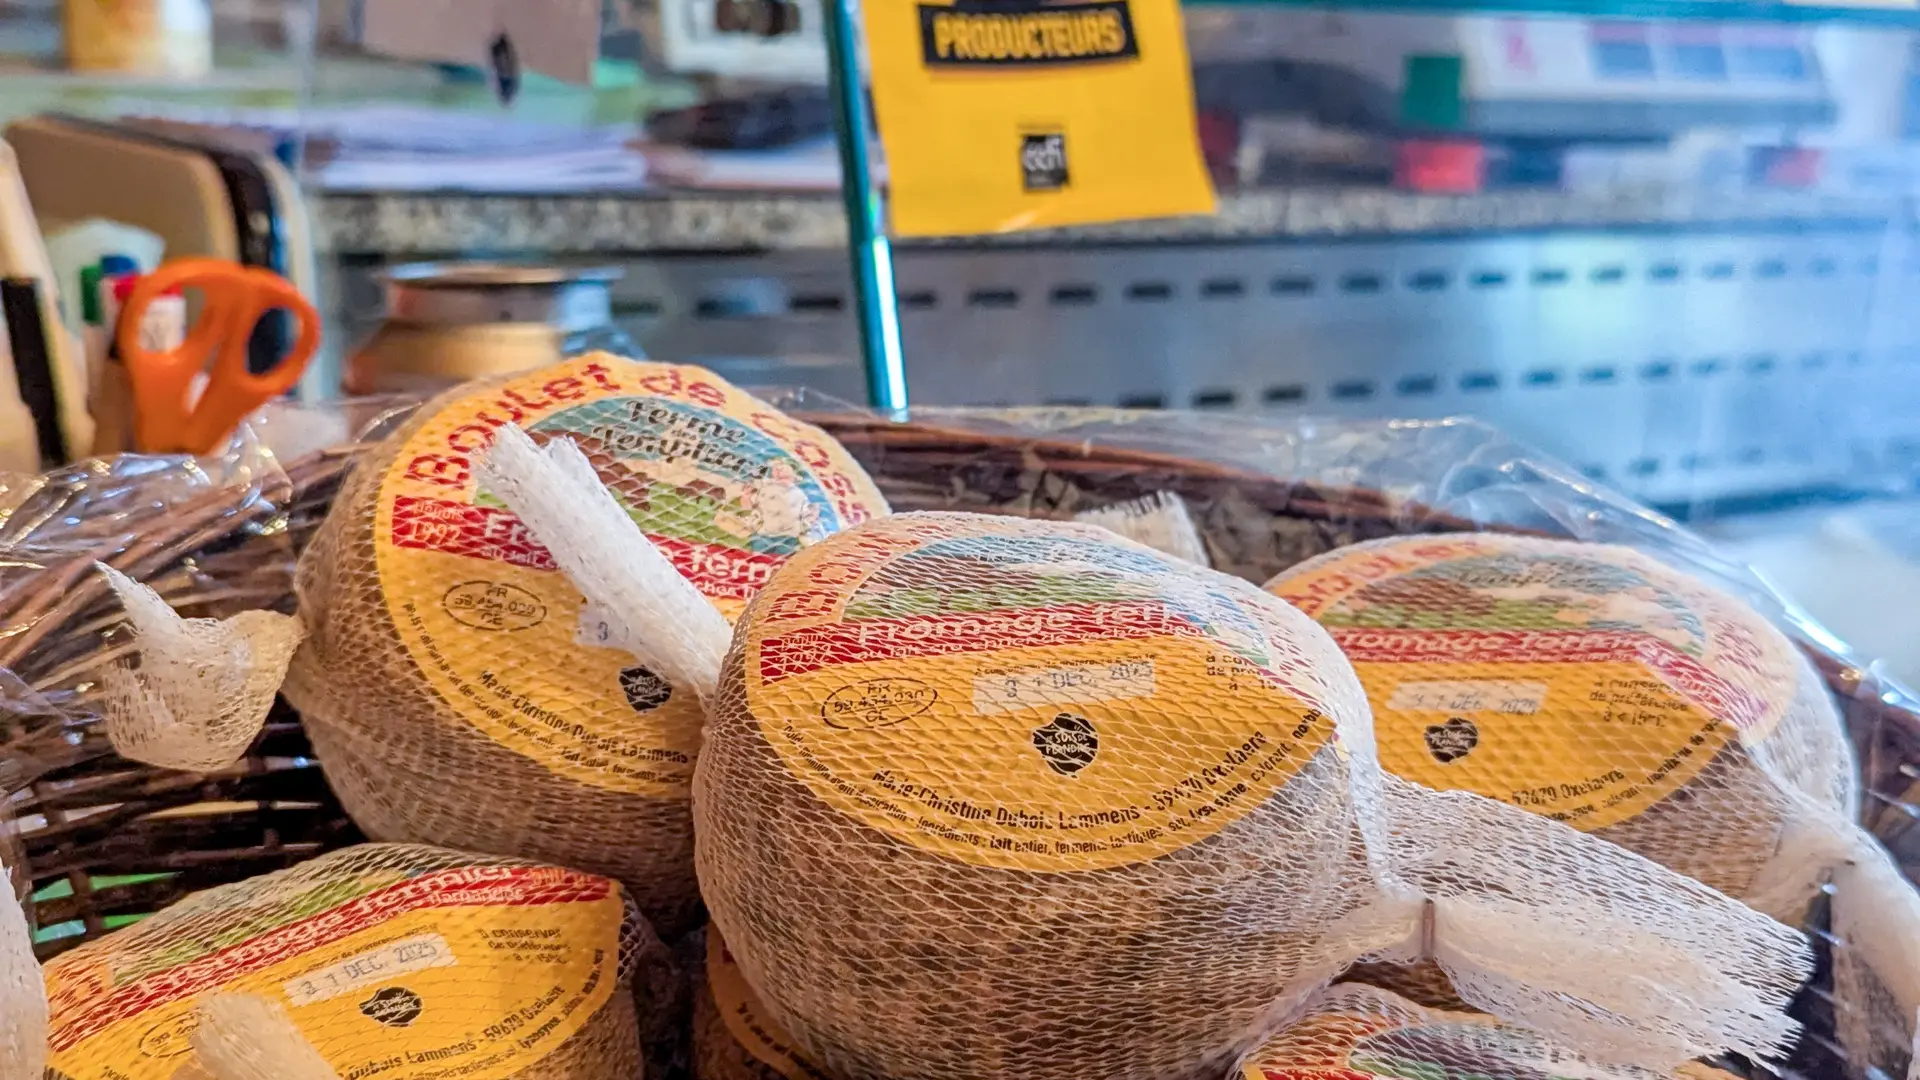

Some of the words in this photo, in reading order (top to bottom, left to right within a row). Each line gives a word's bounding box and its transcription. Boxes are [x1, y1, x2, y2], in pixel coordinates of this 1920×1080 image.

[933, 8, 1126, 58] PRODUCTEURS
[640, 368, 725, 408] de
[626, 400, 748, 444] Ferme
[409, 521, 461, 546] 1992
[859, 609, 1073, 645] Fromage
[871, 766, 991, 821] Marie-Christine
[996, 806, 1053, 830] Dubois
[1059, 806, 1141, 830] Lammens
[405, 1039, 478, 1066] Lammens
